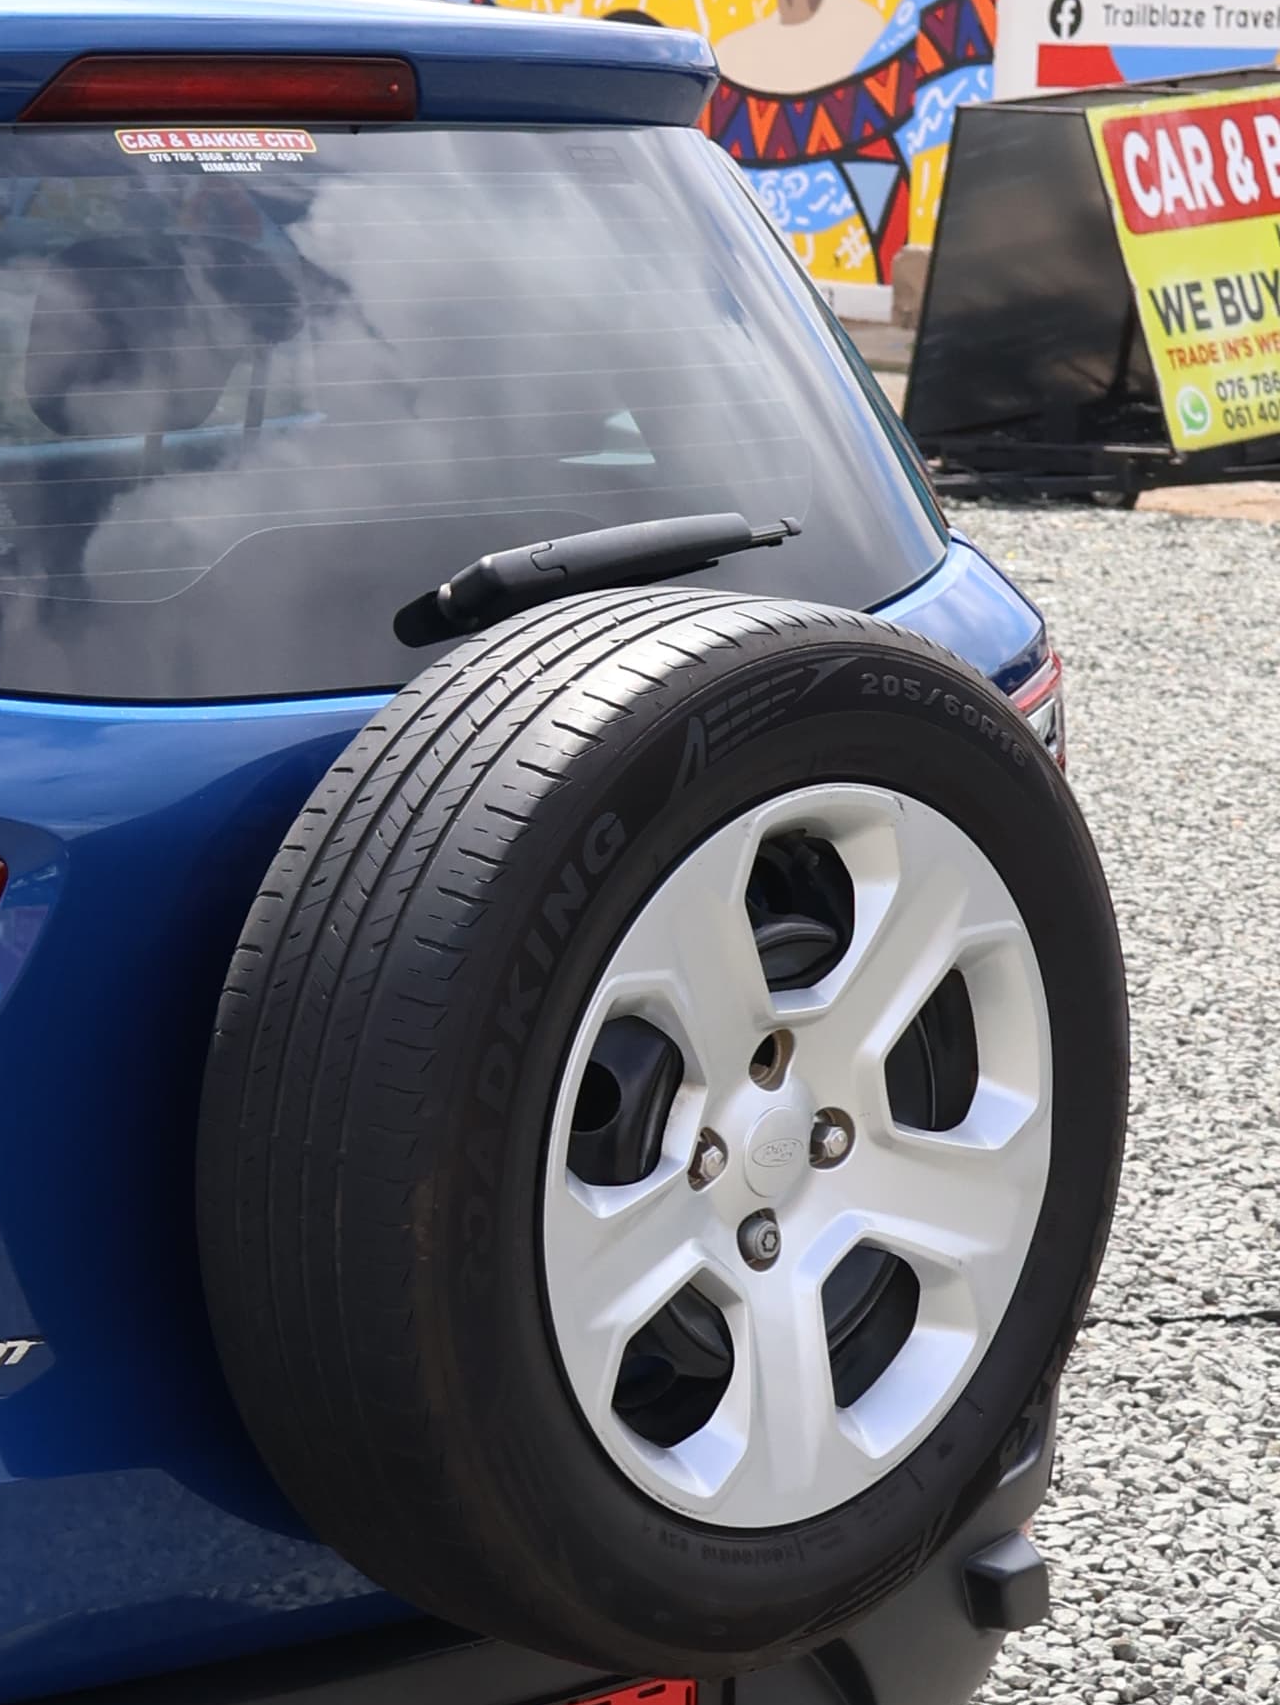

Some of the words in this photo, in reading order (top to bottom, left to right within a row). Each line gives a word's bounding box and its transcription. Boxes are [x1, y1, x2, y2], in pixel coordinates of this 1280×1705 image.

[1102, 4, 1206, 28] Trailblaze
[122, 133, 165, 148] CAR
[168, 133, 185, 147] &
[187, 133, 260, 147] BAKKIE
[264, 133, 308, 148] CITY
[201, 162, 262, 172] KIMBERLEY
[1123, 124, 1225, 218] CAR
[1221, 118, 1262, 205] &
[1148, 280, 1212, 336] WE
[1214, 269, 1280, 327] BUY
[1166, 340, 1221, 370] TRADE
[1215, 376, 1248, 402] 076
[1223, 404, 1254, 429] 061
[1258, 400, 1280, 425] 40
[859, 672, 1030, 768] 205/60R16
